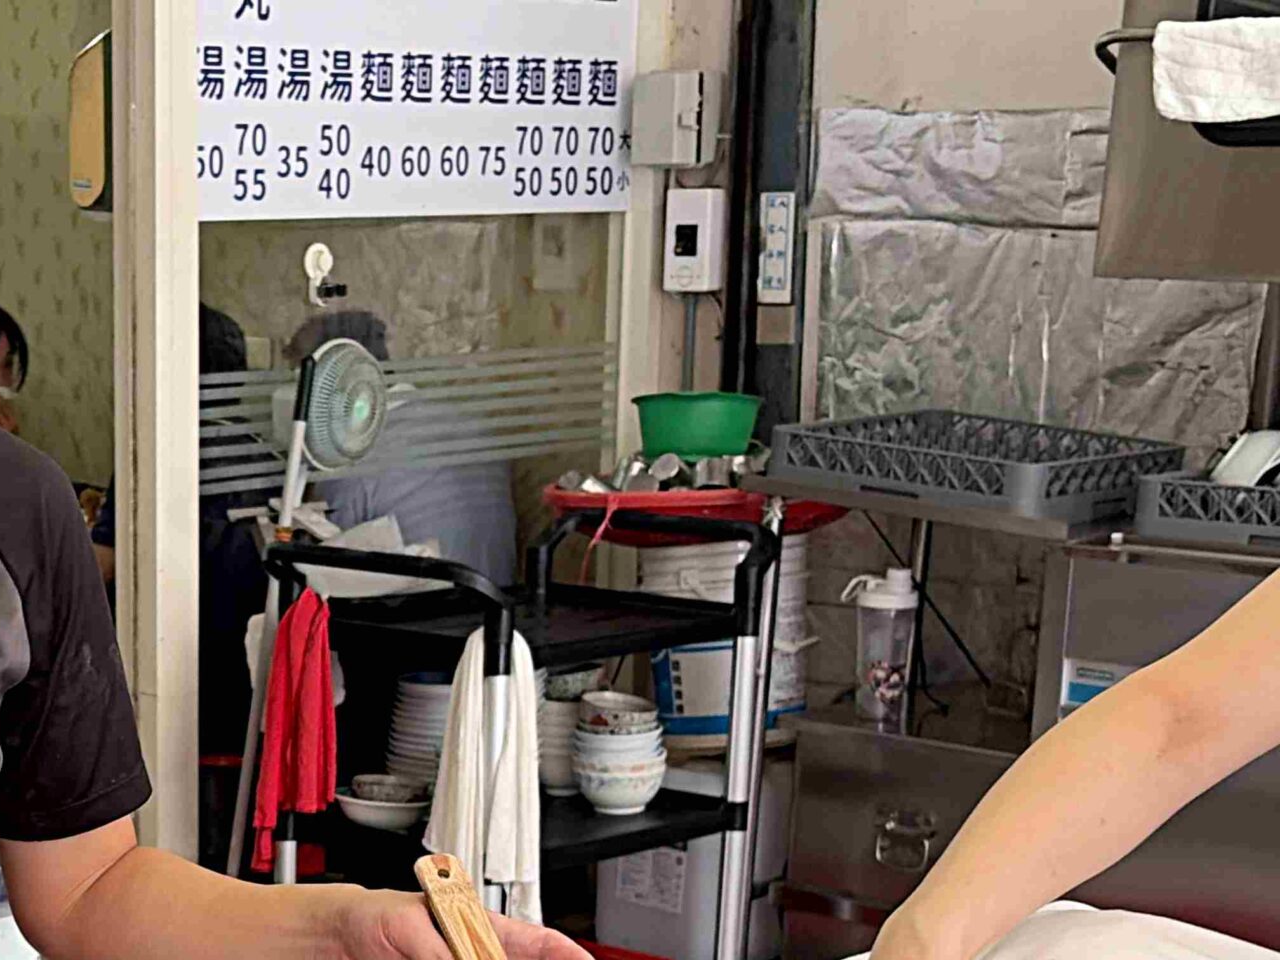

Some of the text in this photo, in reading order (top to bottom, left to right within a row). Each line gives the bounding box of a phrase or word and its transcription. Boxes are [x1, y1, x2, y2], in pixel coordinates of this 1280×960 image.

[233, 45, 269, 100] 湯
[277, 47, 312, 102] 湯
[320, 49, 354, 103] 湯
[360, 50, 394, 103] 麵
[400, 51, 434, 103] 麵
[440, 52, 472, 104] 麵
[479, 54, 510, 104] 麵
[516, 55, 546, 105] 麵
[552, 57, 582, 106] 麵
[588, 58, 618, 106] 麵
[234, 123, 632, 156] 70 50 70 70 70 大
[277, 145, 308, 177] 35
[360, 145, 391, 177] 40
[401, 146, 430, 177] 60
[440, 146, 469, 176] 60
[478, 146, 506, 176] 75
[233, 166, 630, 201] 55 40 50 50 50 小
